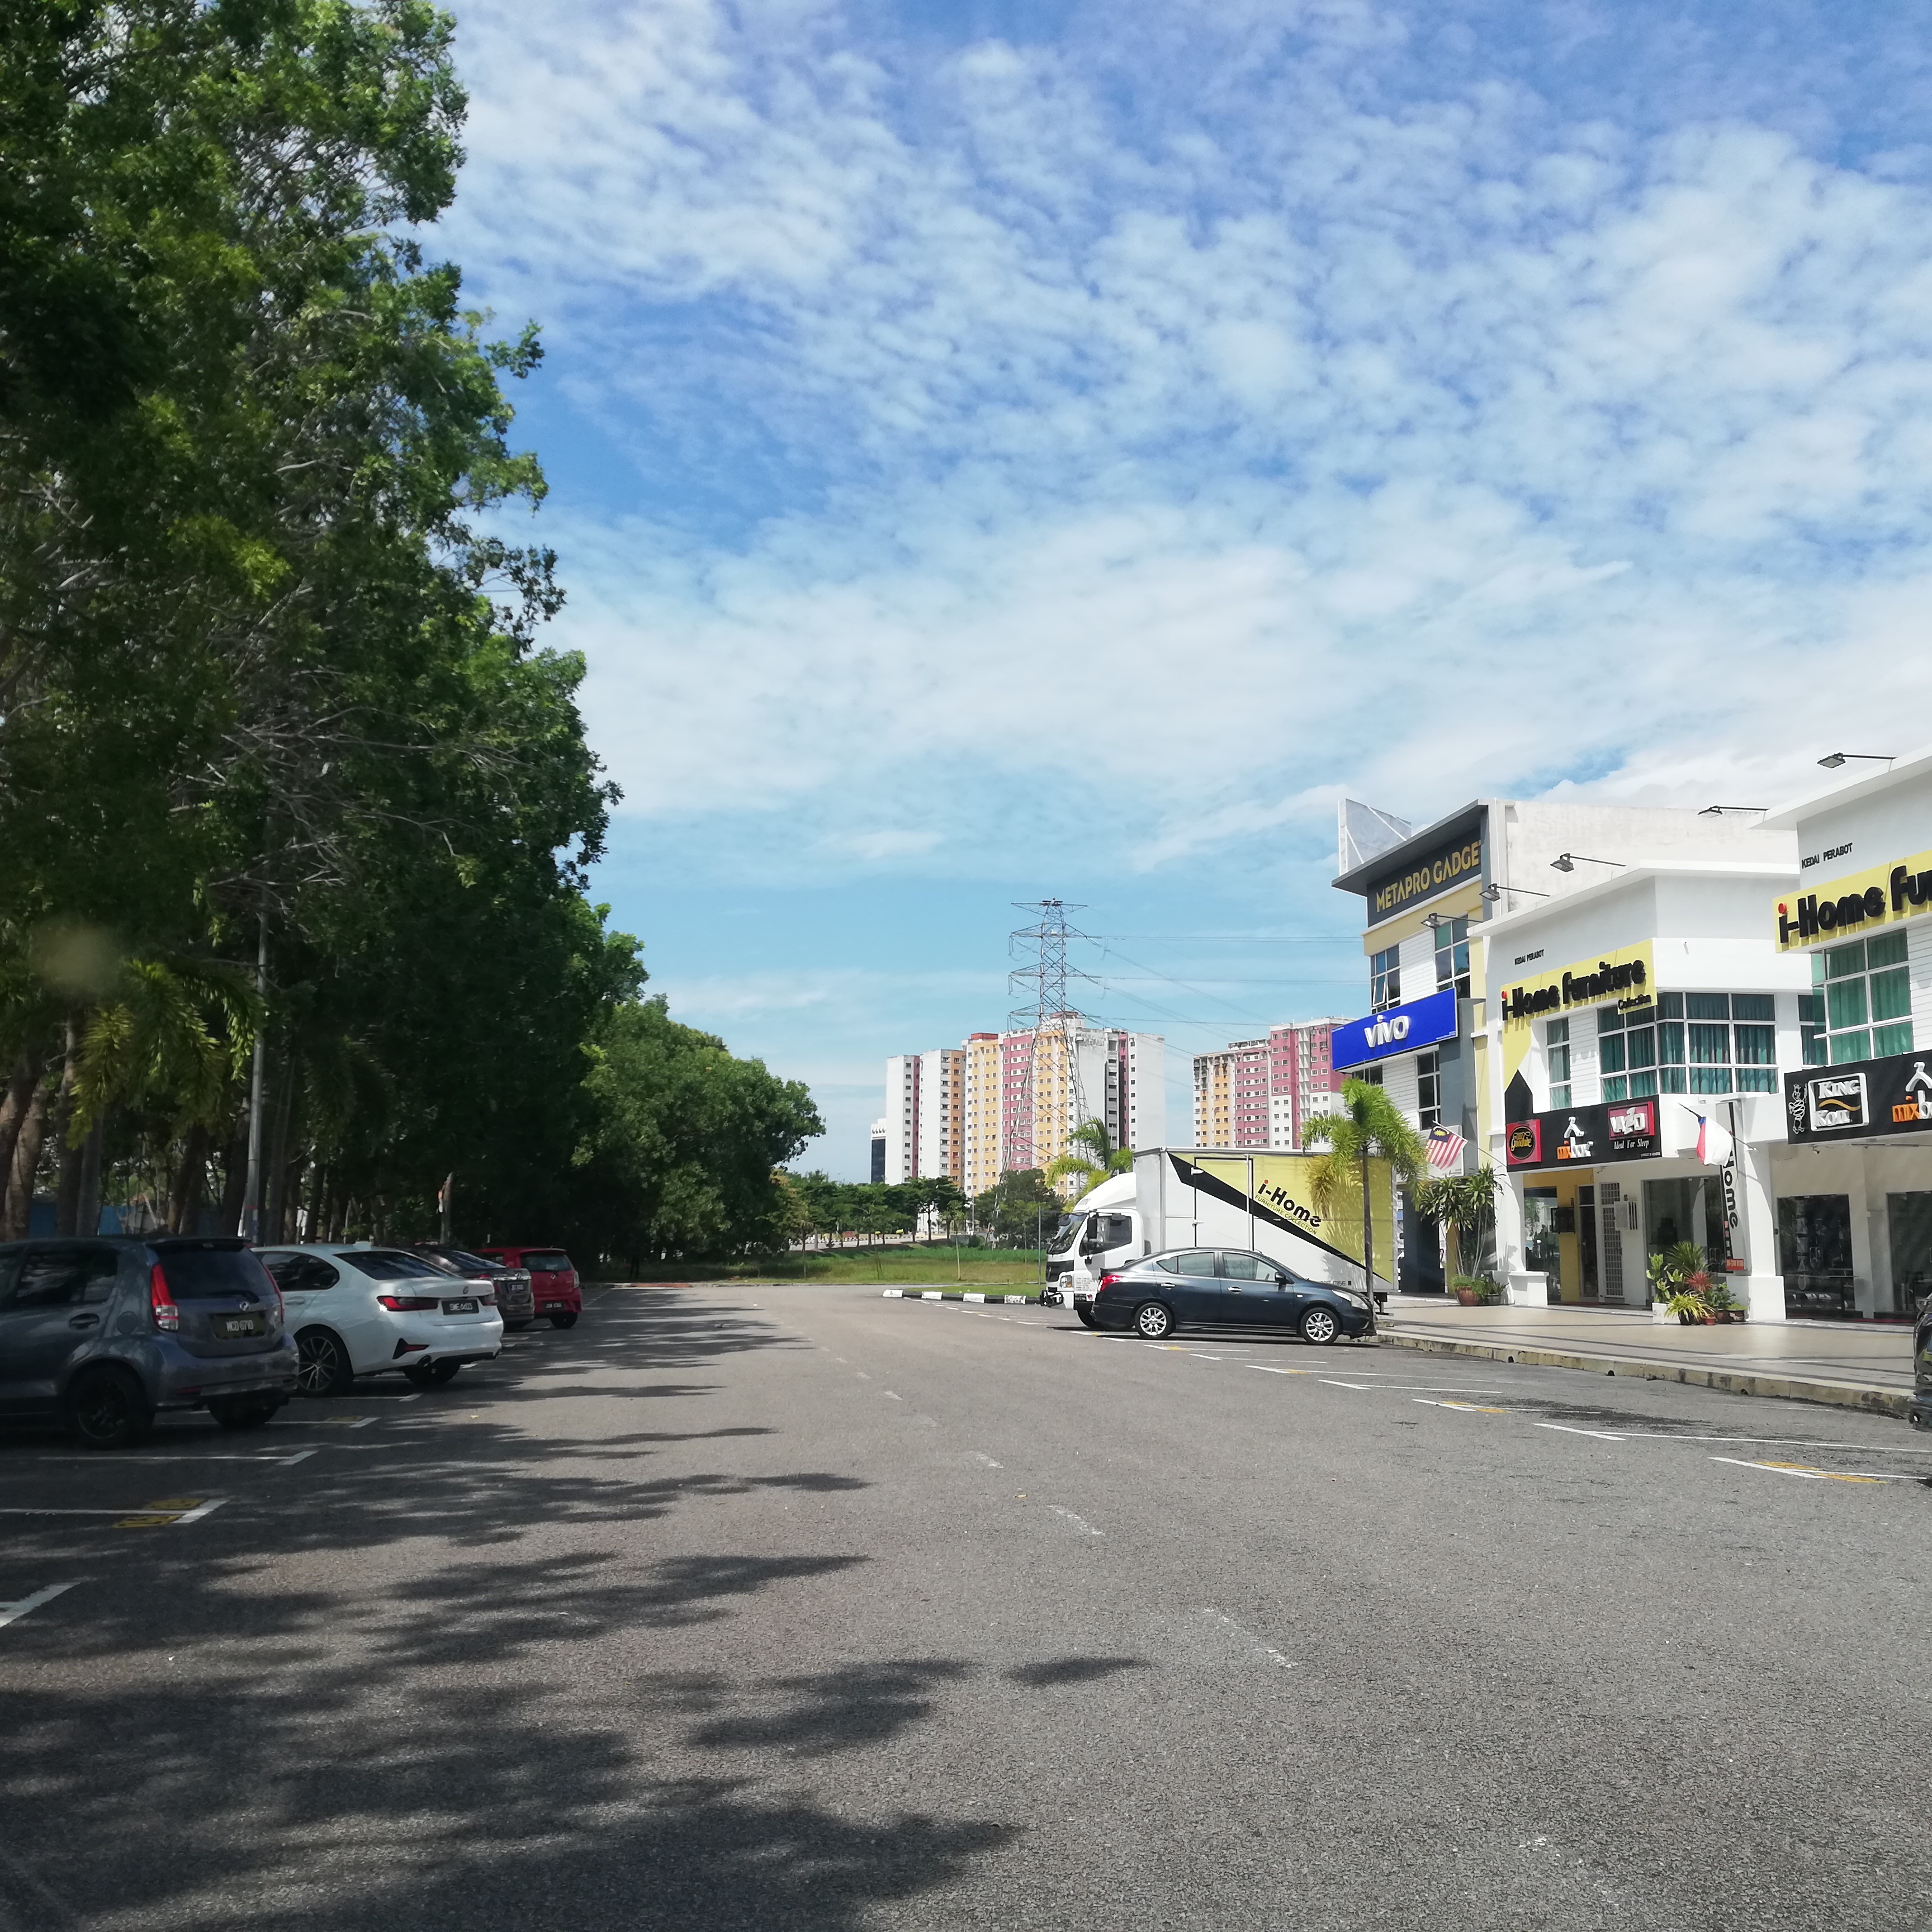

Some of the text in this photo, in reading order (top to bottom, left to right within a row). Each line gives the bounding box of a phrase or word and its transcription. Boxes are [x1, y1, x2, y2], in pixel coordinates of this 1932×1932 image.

[1801, 842, 1853, 869] KEDAI PERABOT
[1376, 840, 1481, 913] METAPRO GADGE
[1514, 949, 1544, 965] KEDAI PERABOT
[1364, 1015, 1410, 1048] vivo
[1818, 1079, 1860, 1099] KING
[1892, 1090, 1932, 1123] mixb
[1614, 1140, 1625, 1149] Ideal
[1637, 1138, 1649, 1149] Sleep
[1254, 1195, 1317, 1235] FURNITURE COLLECTION
[1258, 1180, 1322, 1227] i-Home
